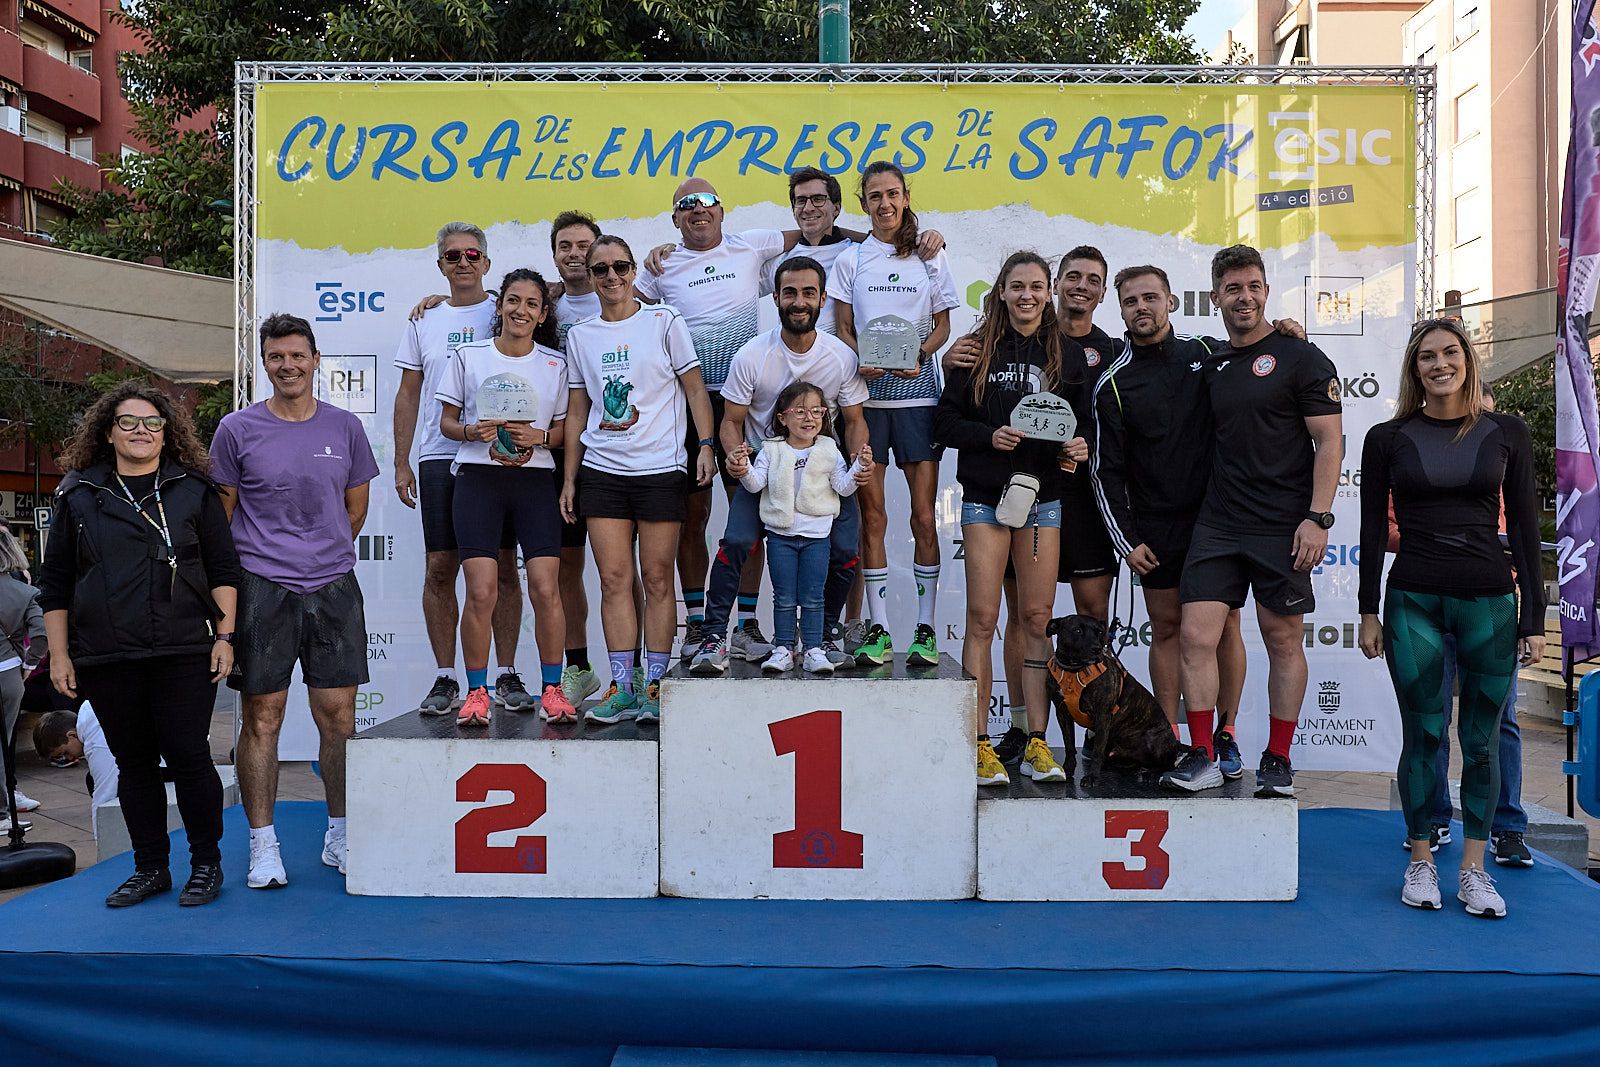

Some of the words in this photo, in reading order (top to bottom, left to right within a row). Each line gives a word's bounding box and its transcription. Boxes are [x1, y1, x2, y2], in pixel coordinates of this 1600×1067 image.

[533, 115, 573, 143] DE
[957, 108, 994, 137] DE
[276, 115, 521, 182] CURSA
[591, 119, 934, 178] EMPRESES
[944, 143, 993, 172] LA
[1008, 115, 1258, 181] SAFOR
[525, 152, 589, 181] LES
[1287, 187, 1349, 206] edició
[688, 273, 736, 288] CHRISTEYNS
[1317, 292, 1350, 313] RH
[330, 370, 364, 392] RH
[38, 510, 49, 528] P
[1311, 733, 1368, 747] GANDIA
[767, 710, 863, 869] 1
[455, 763, 547, 875] 2
[1102, 810, 1170, 890] 3
